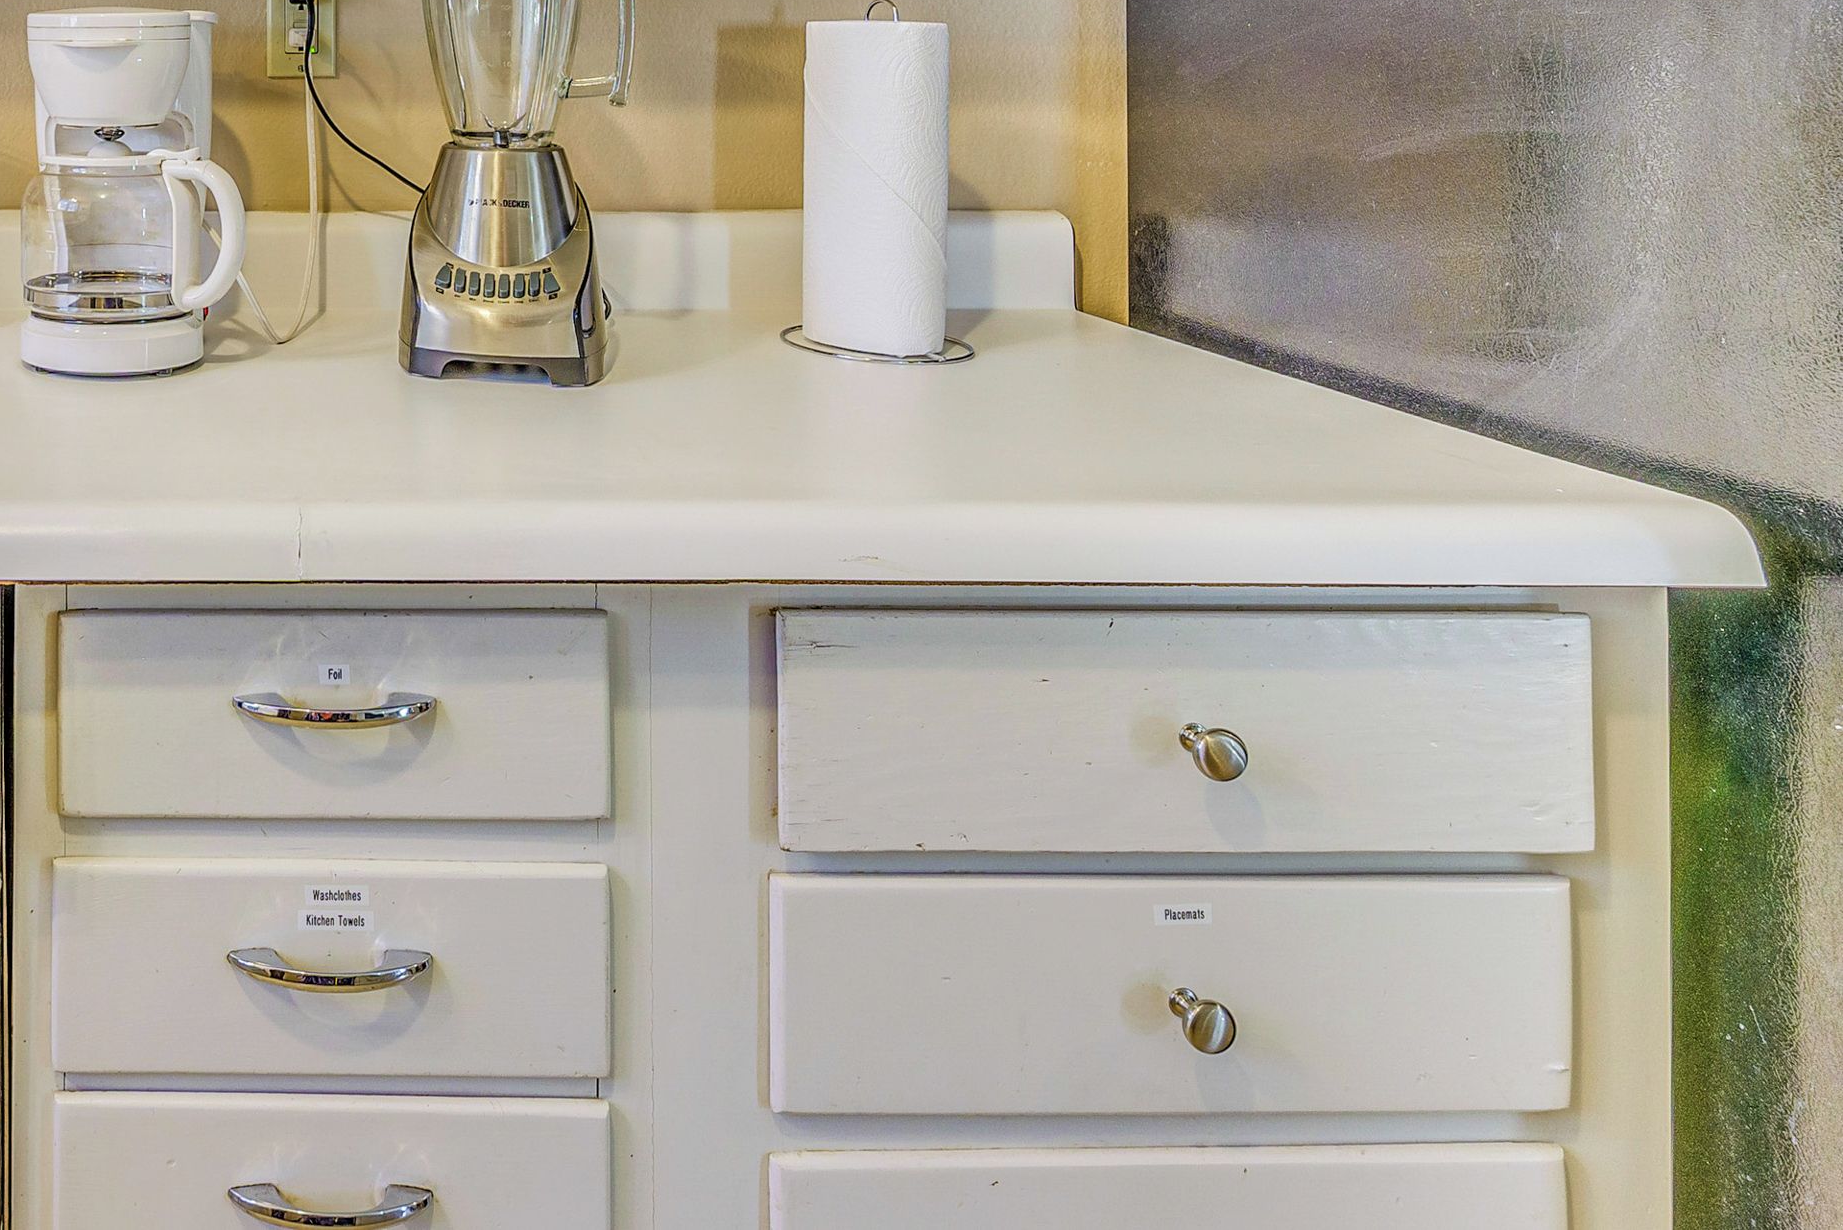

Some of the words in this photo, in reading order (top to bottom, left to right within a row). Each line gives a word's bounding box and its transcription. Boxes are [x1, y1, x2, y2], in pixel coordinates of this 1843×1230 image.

[328, 668, 343, 680] Foil
[312, 889, 362, 901] Washclothes
[306, 914, 335, 926] Kitchen
[338, 915, 365, 927] Towels
[1164, 908, 1205, 921] Placemats
